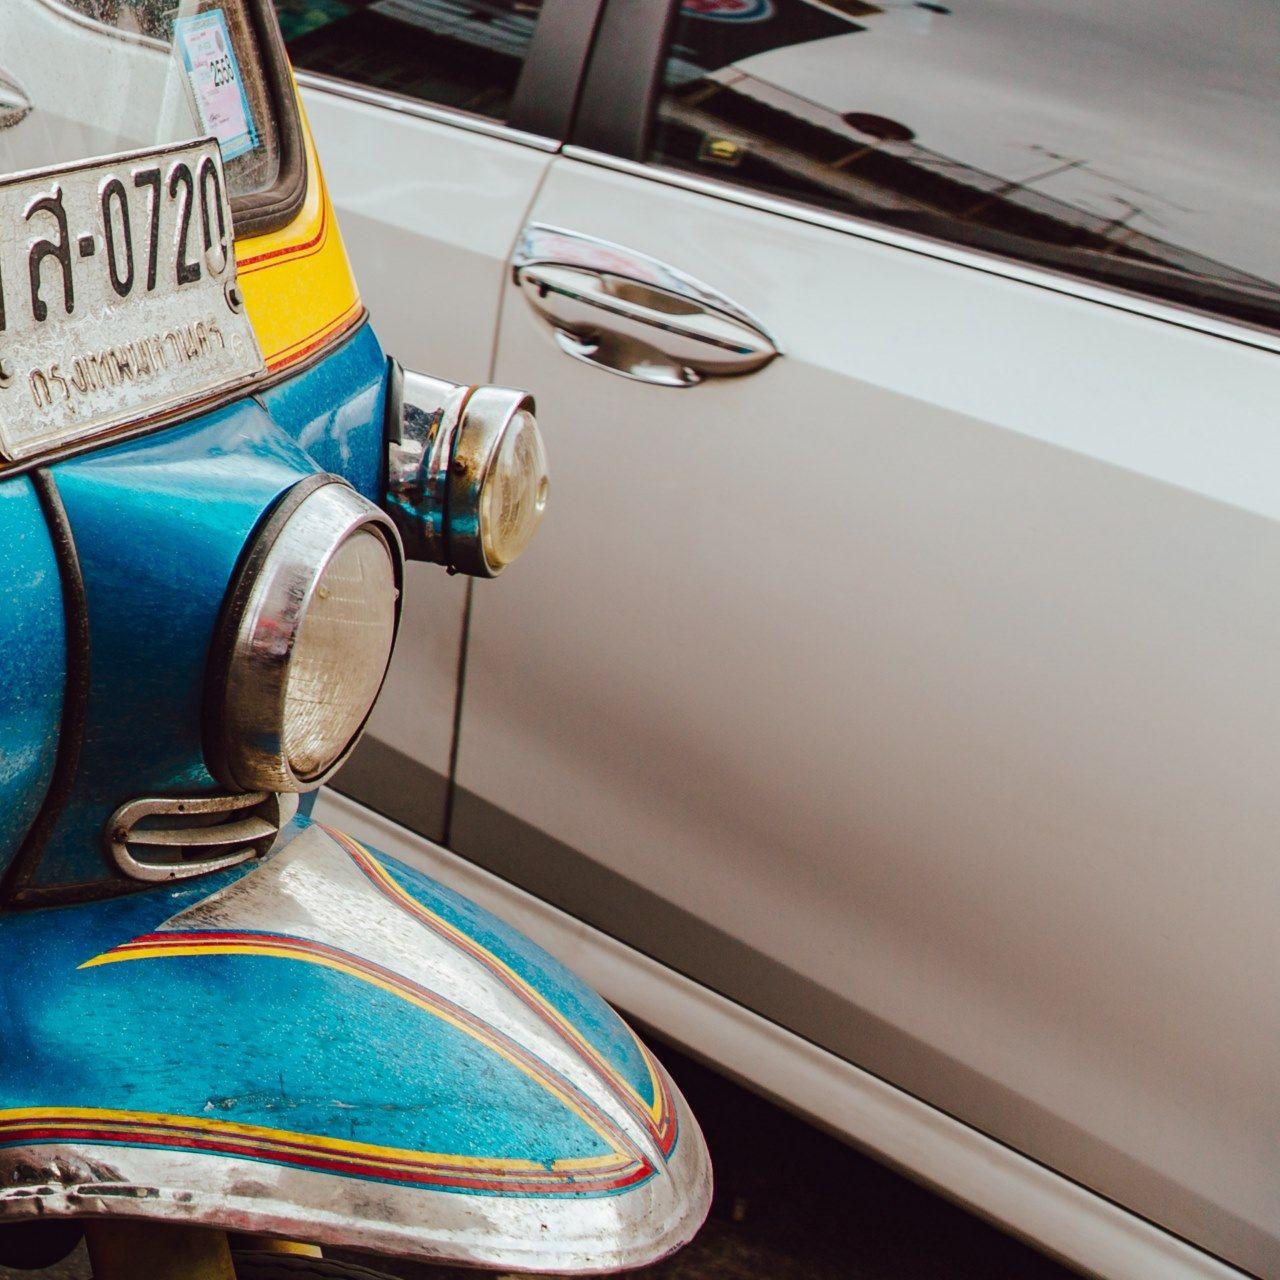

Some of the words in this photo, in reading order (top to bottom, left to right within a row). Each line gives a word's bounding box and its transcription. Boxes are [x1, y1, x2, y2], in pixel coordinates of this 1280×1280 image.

[28, 319, 227, 415] กรุงเทพมหานคร
